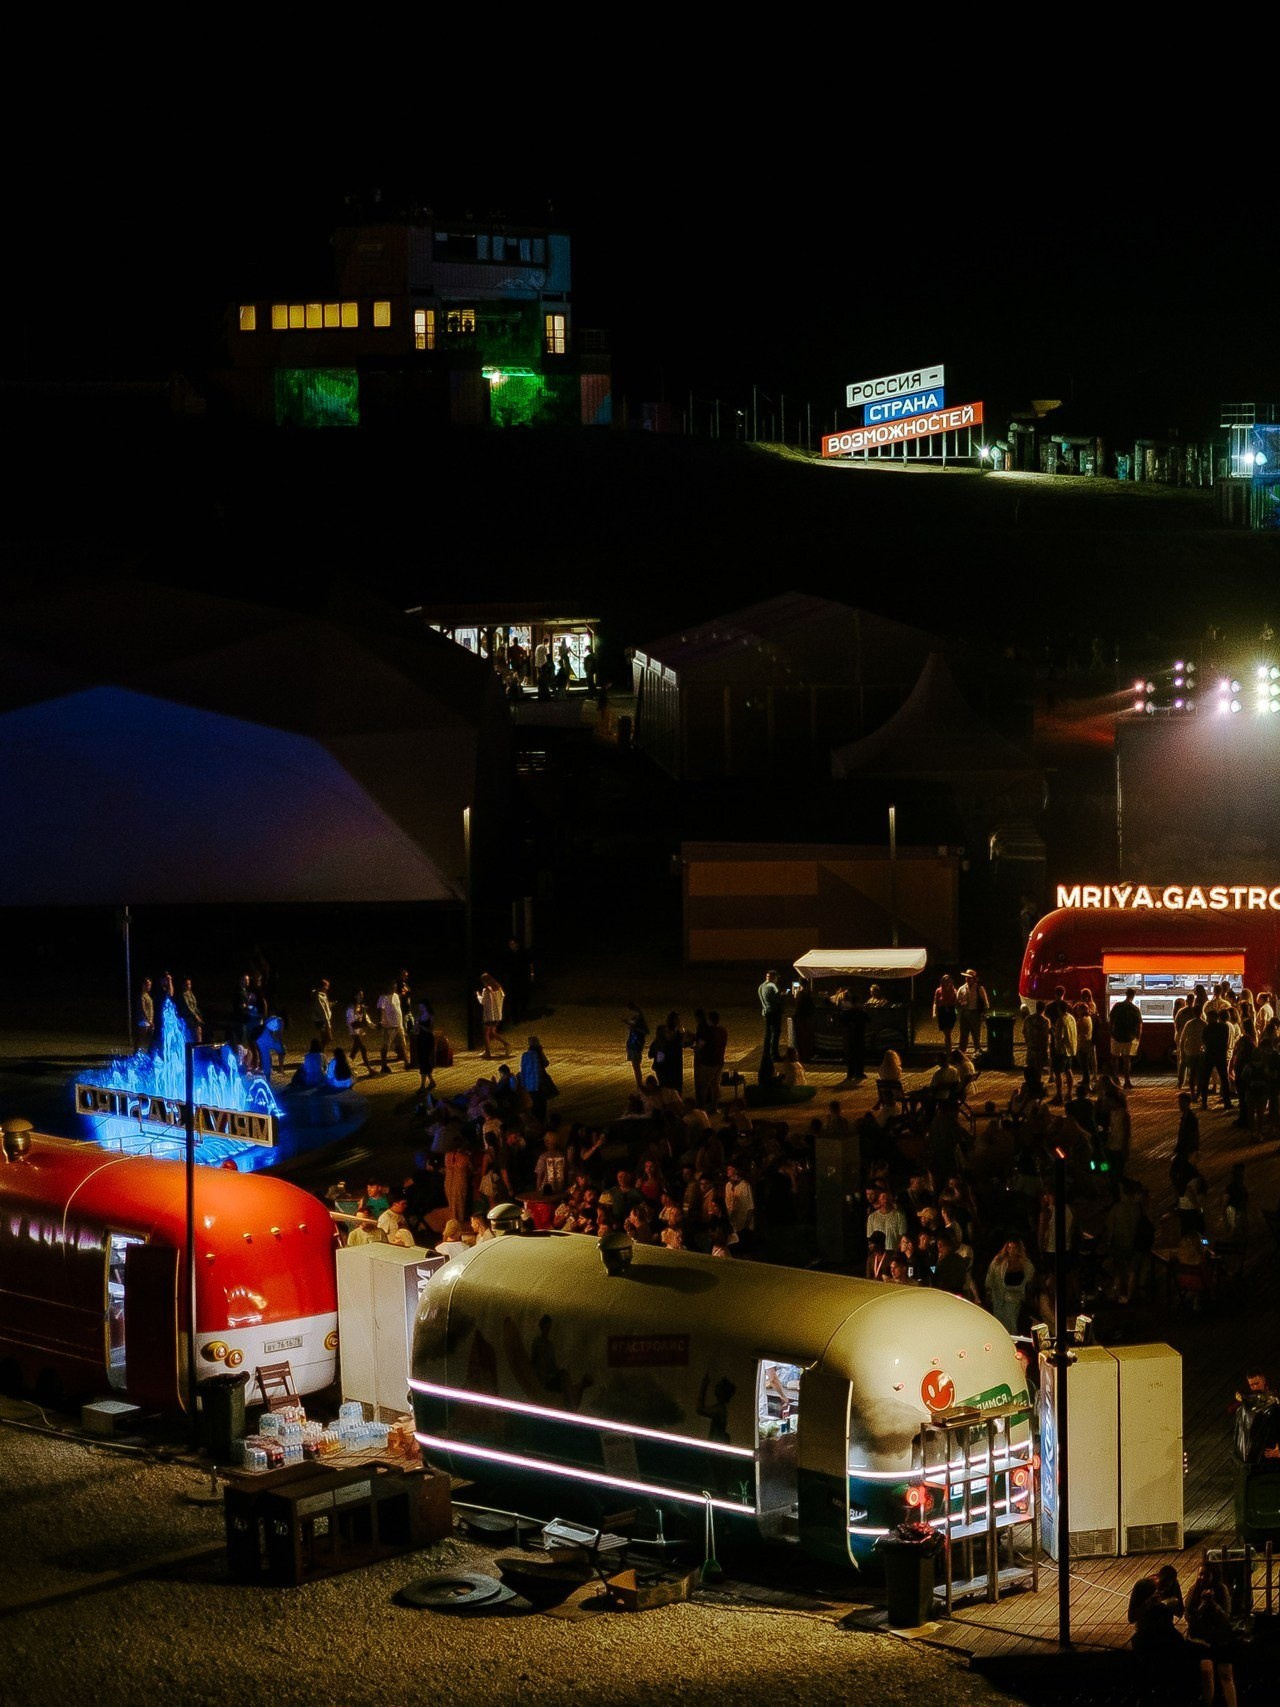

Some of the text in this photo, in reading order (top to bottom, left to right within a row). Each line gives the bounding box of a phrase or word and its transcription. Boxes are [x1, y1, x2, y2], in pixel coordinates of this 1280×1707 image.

[852, 374, 921, 400] РОССИЯ
[869, 393, 938, 421] СТРАНА
[828, 405, 974, 453] ВОЗМОЖНОСТЕЙ
